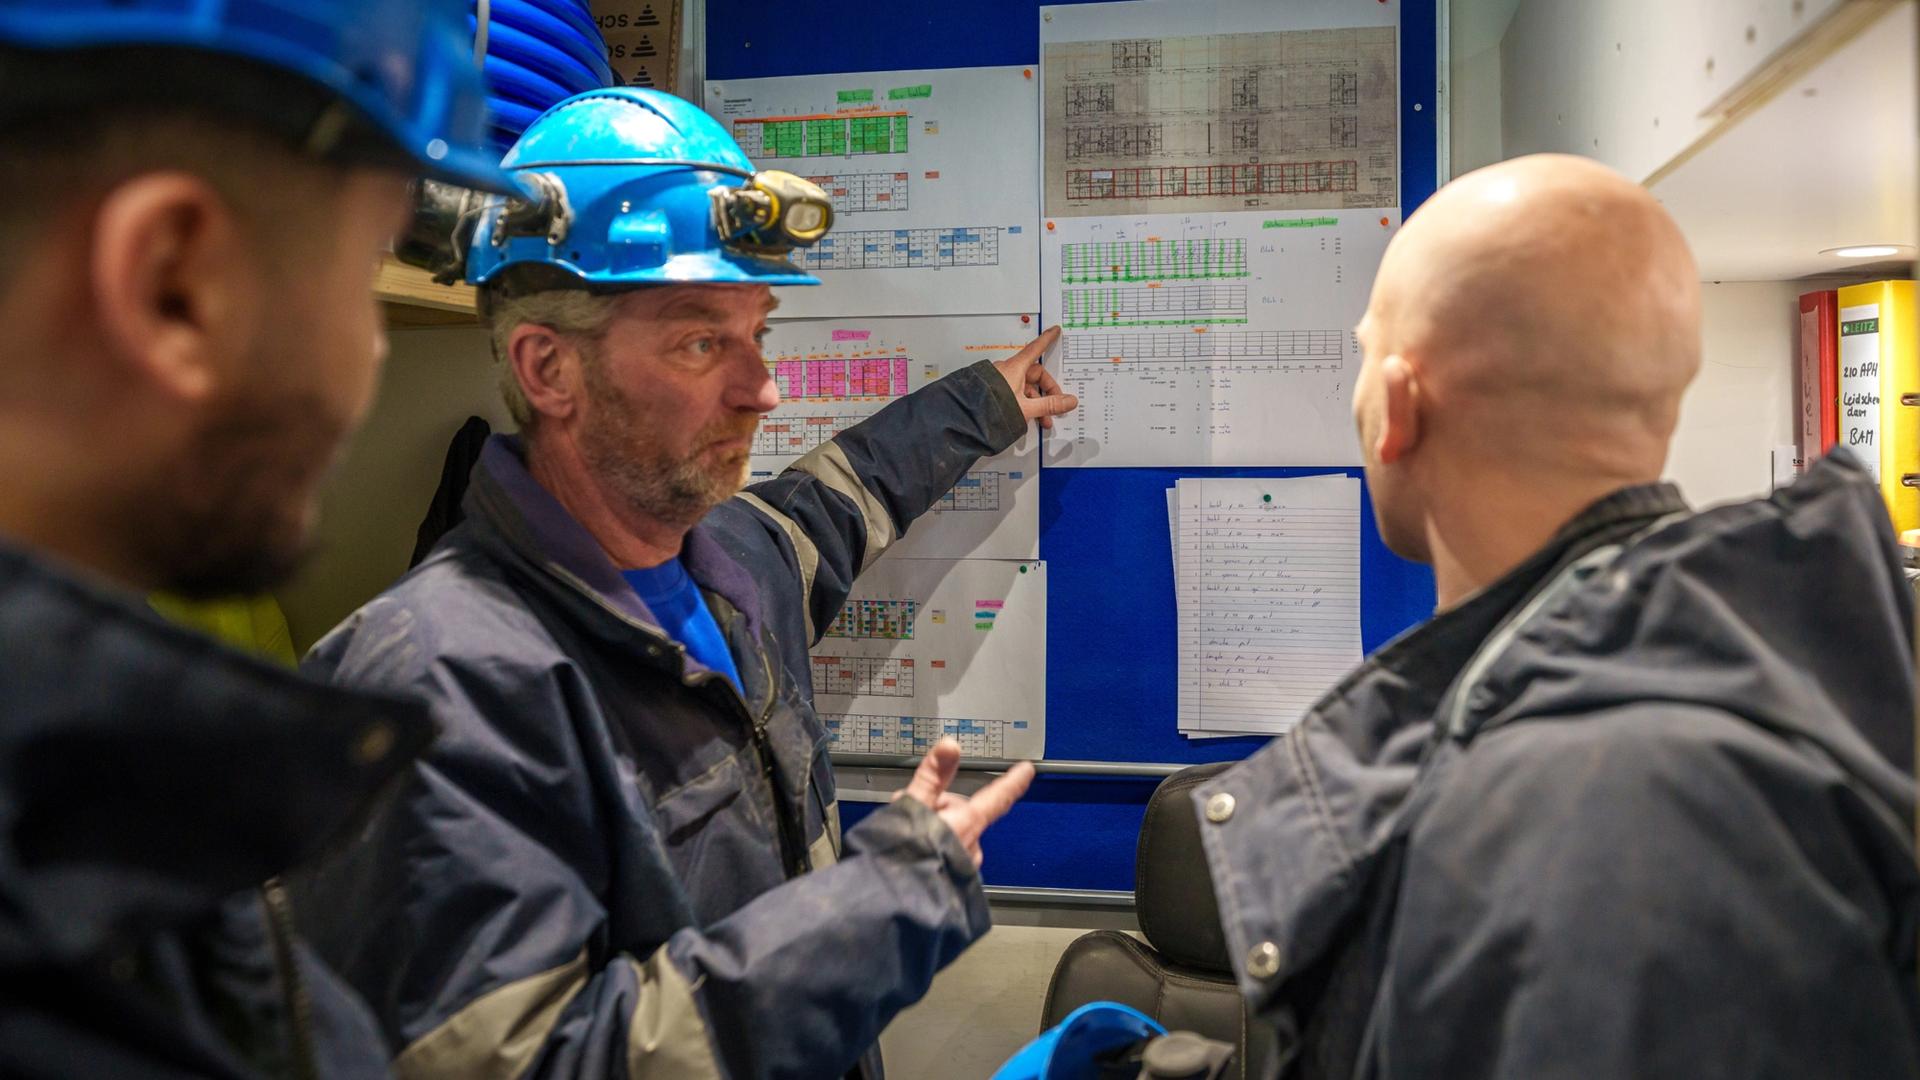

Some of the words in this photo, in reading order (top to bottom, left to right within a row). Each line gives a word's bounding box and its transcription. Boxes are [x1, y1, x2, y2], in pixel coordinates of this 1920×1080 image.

[1850, 320, 1875, 333] LEITZ
[1843, 366, 1858, 378] 210
[1859, 361, 1879, 378] APH
[1849, 427, 1874, 446] BAM
